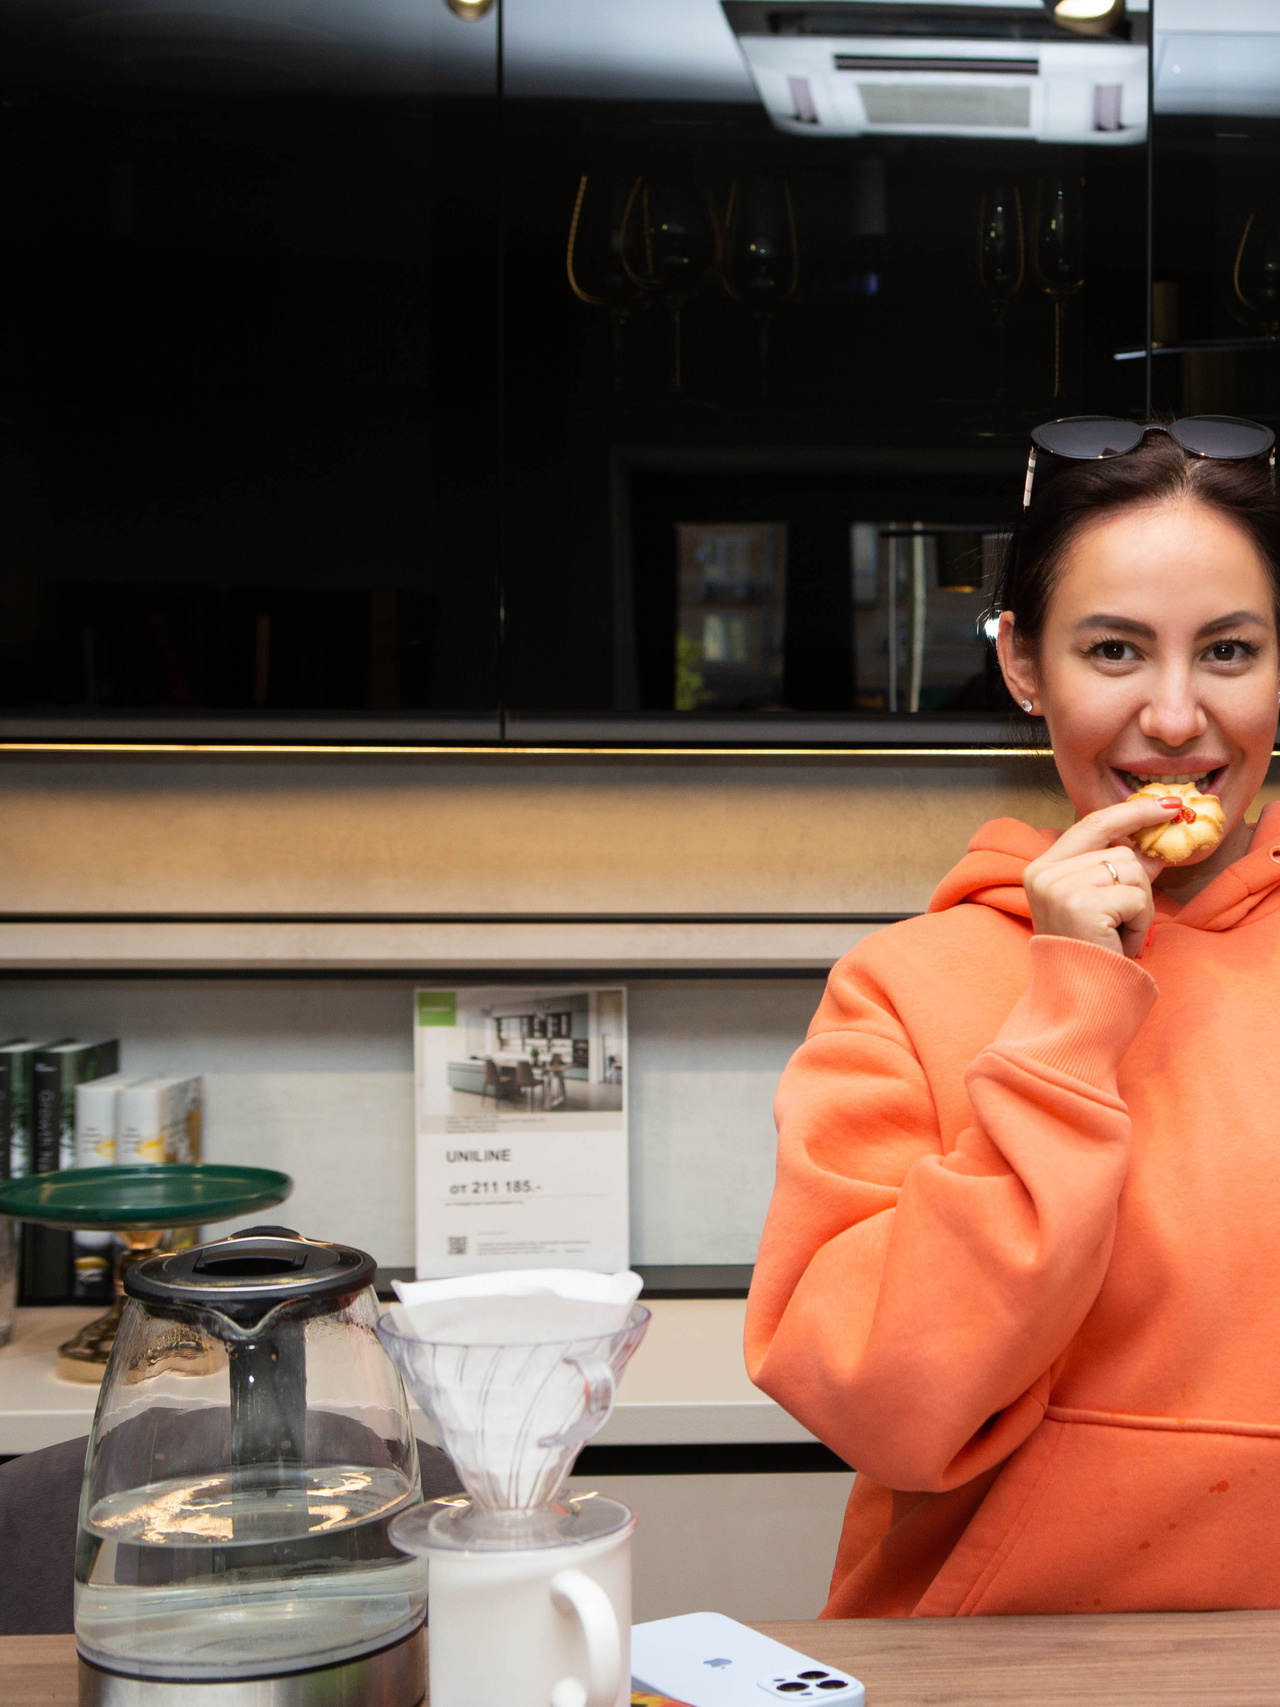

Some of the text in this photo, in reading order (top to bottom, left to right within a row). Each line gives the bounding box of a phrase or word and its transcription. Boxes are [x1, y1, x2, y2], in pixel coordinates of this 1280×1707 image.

[447, 1150, 510, 1162] UNILINE
[450, 1184, 466, 1194] от
[472, 1181, 498, 1194] 211
